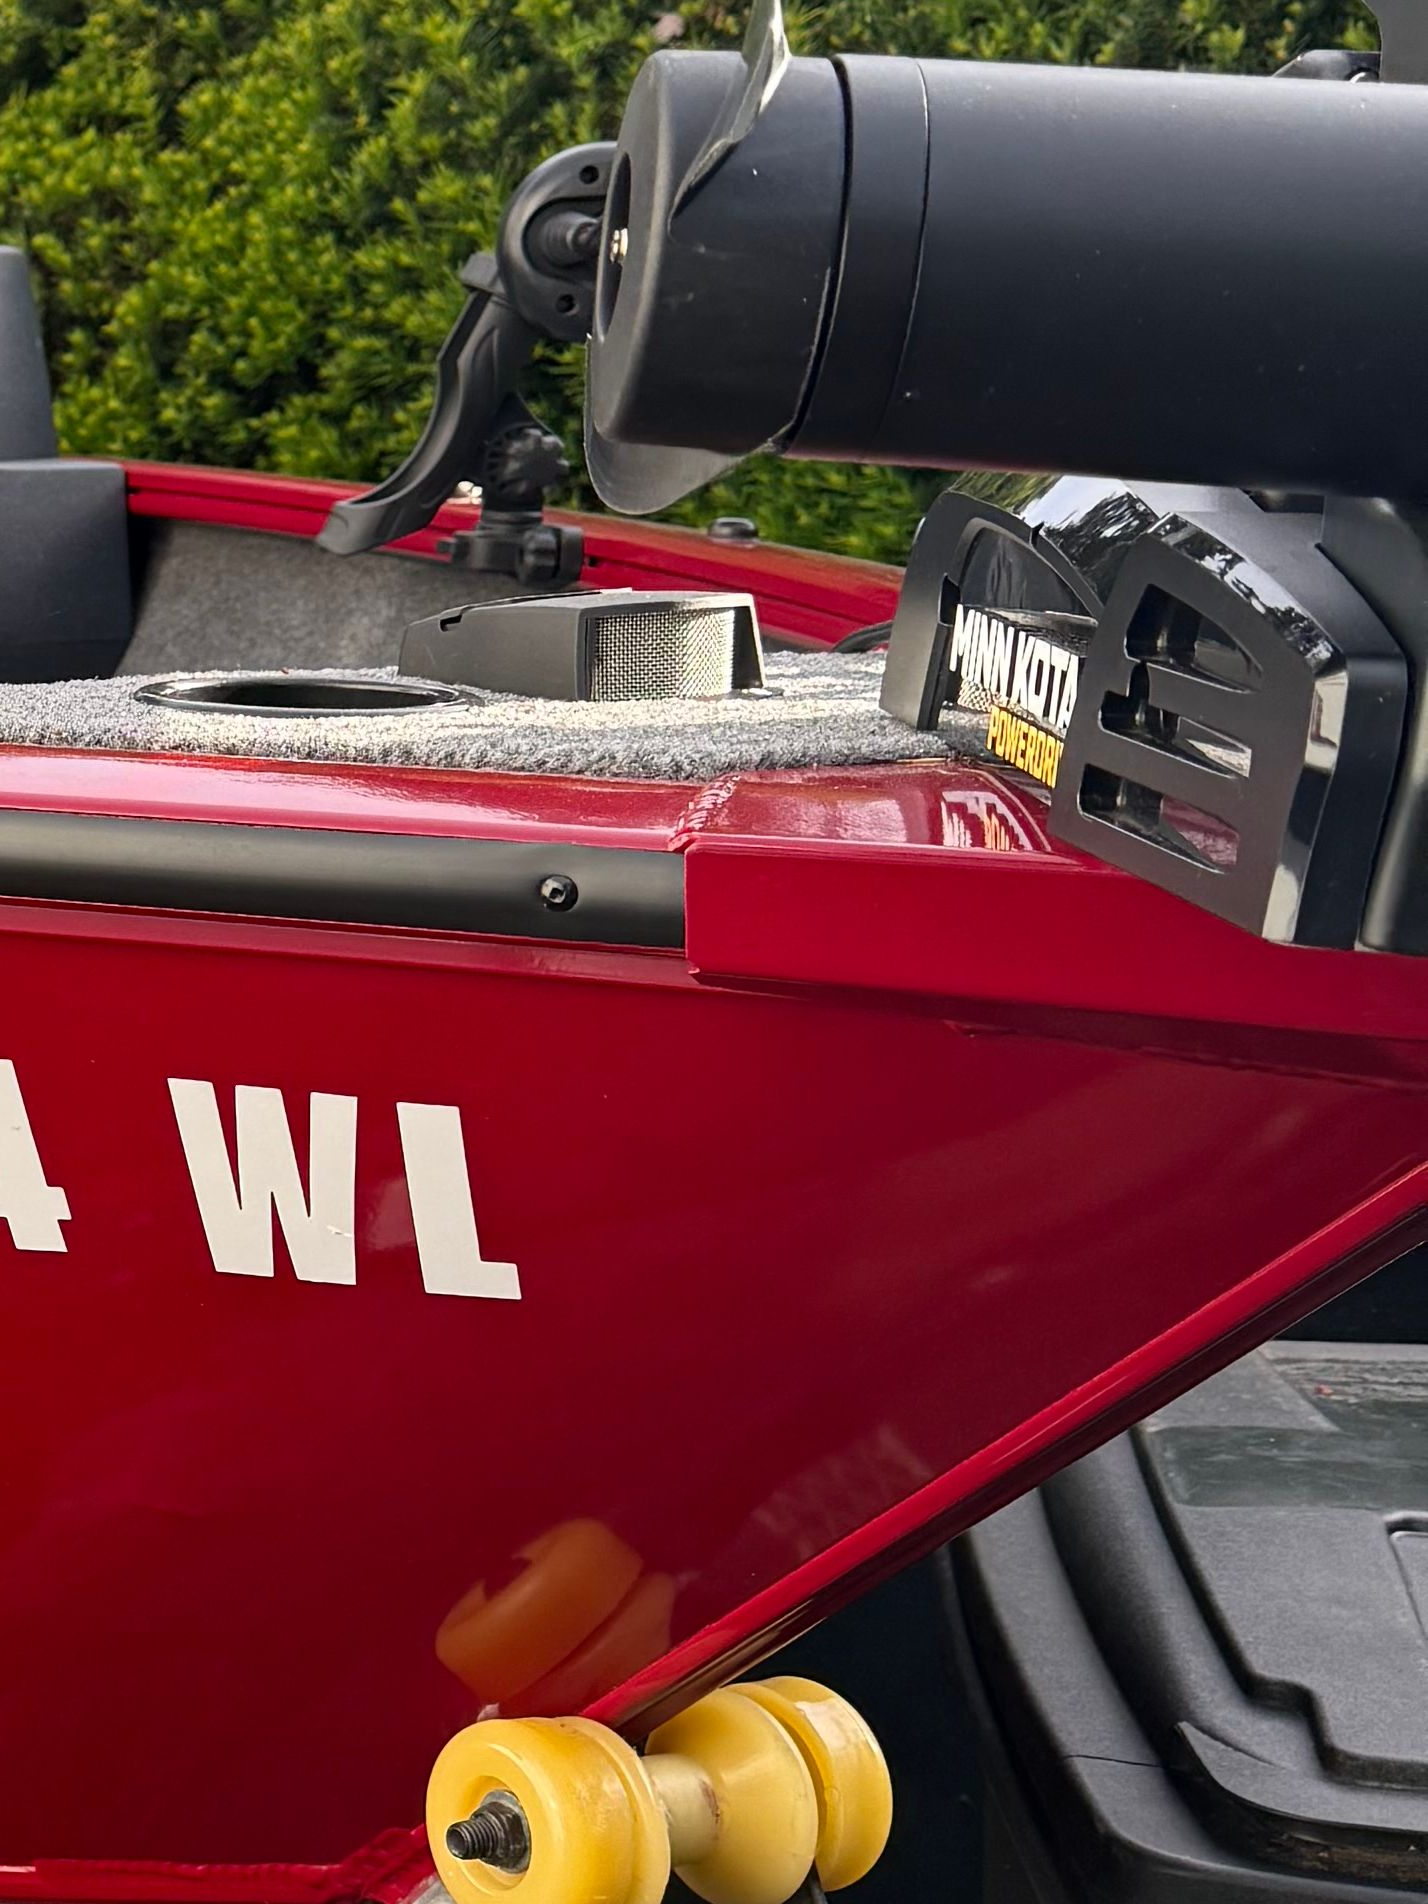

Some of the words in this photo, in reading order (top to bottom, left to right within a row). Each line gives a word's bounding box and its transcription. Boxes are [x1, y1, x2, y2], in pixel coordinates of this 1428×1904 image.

[950, 604, 1014, 700] MINN
[1011, 630, 1079, 740] KOTA
[168, 1077, 522, 1301] WL
